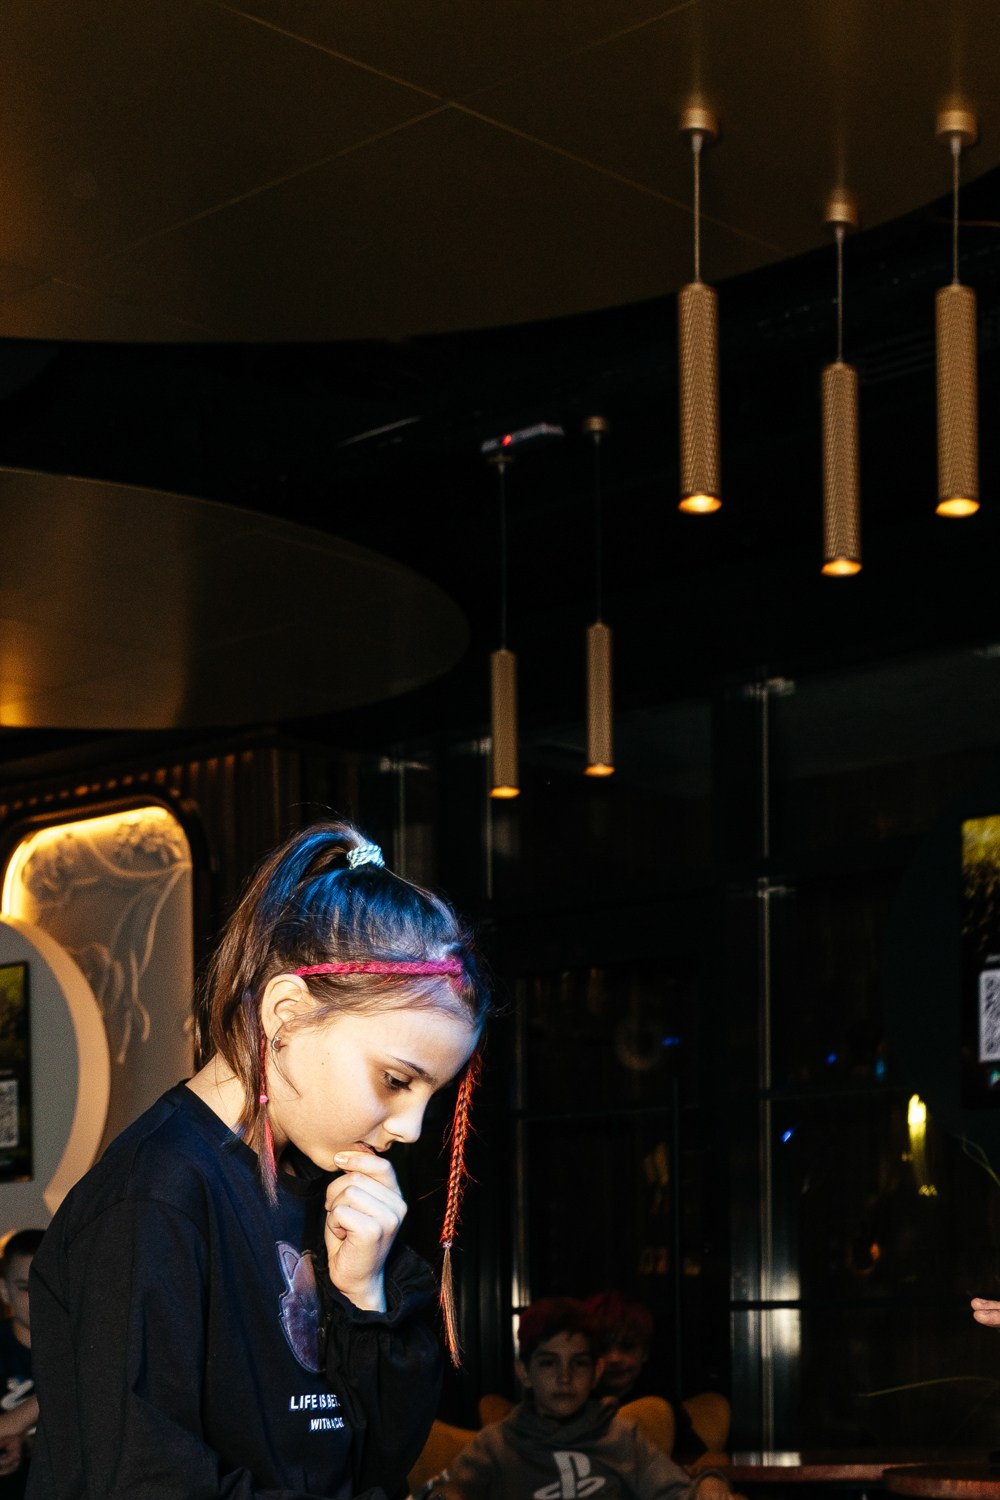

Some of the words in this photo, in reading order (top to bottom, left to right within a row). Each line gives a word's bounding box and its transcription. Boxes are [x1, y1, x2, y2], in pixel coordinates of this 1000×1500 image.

[290, 1395, 318, 1410] LIFE
[319, 1394, 327, 1408] IS
[310, 1418, 331, 1430] WITH
